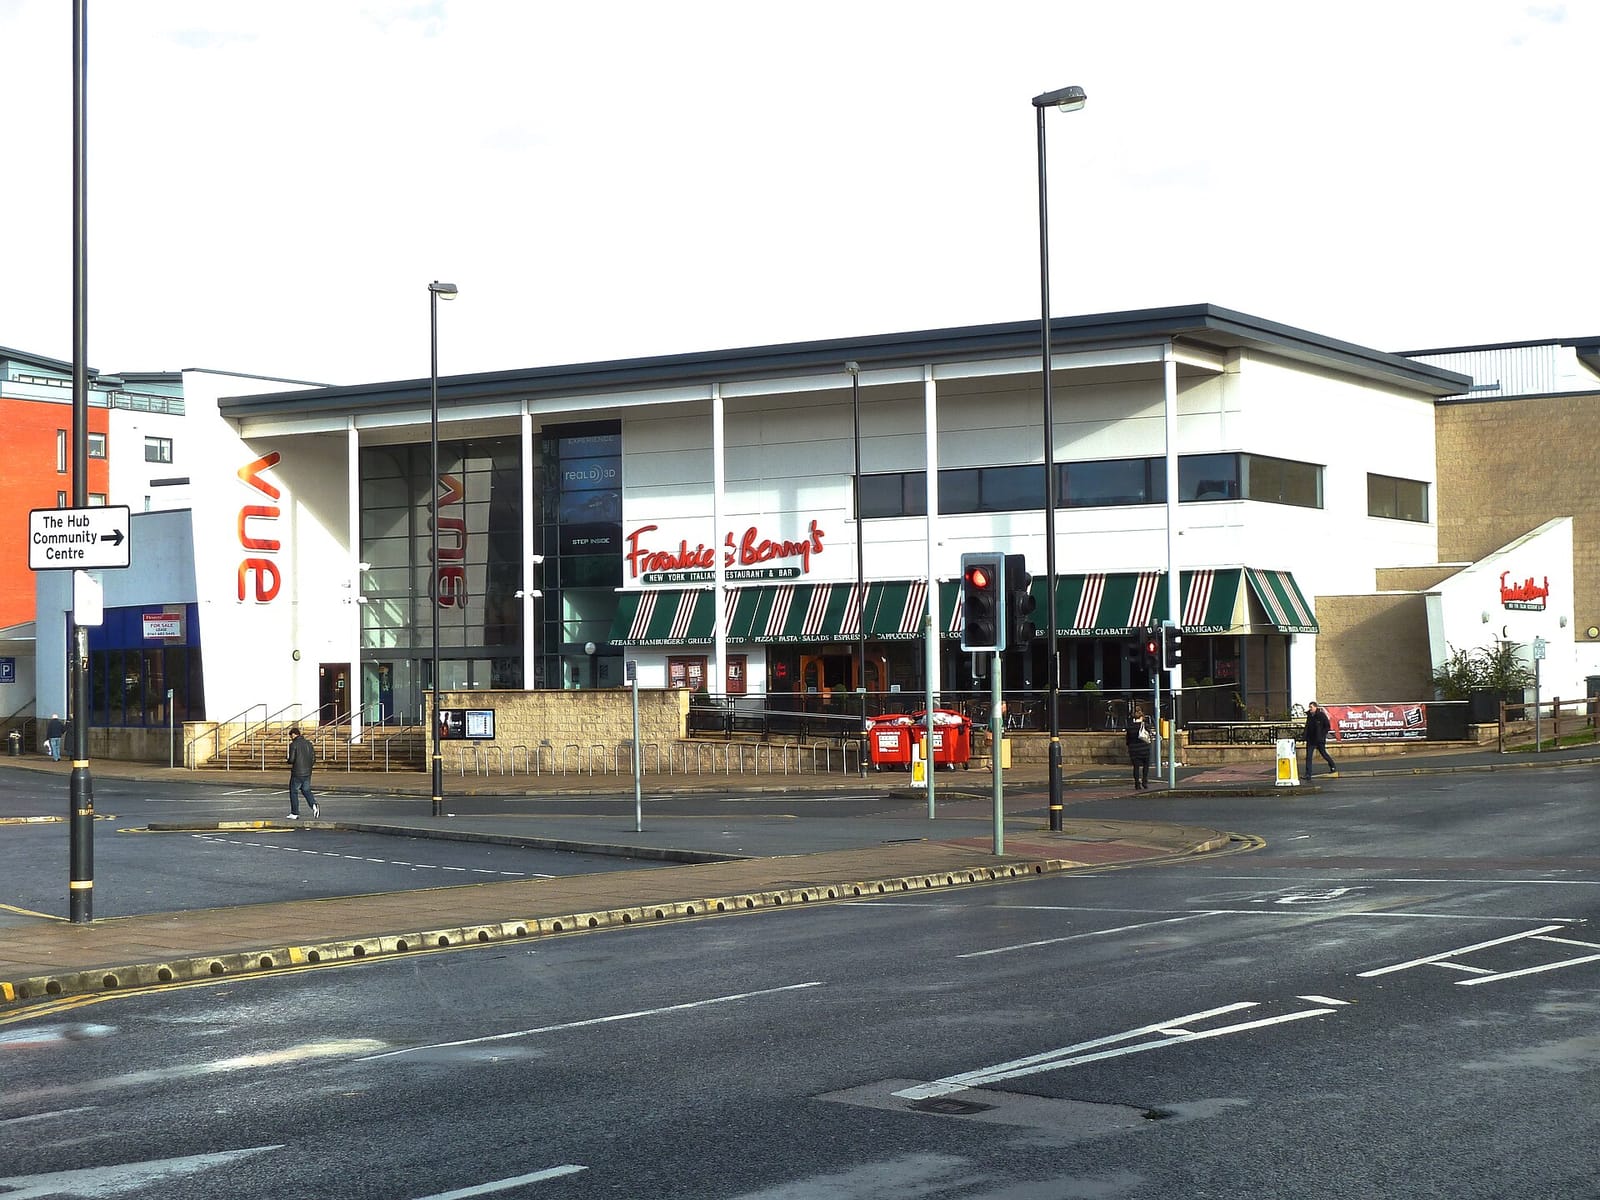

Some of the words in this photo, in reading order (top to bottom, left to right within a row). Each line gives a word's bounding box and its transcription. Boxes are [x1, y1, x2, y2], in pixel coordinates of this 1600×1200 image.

[603, 469, 616, 478] 3D
[43, 515, 63, 529] The
[67, 514, 90, 528] Hub
[237, 451, 281, 602] vue
[33, 530, 97, 544] Community
[46, 547, 84, 560] Centre
[626, 524, 716, 578] Frankie
[739, 519, 825, 574] Benny's
[649, 574, 664, 582] NEW
[668, 573, 685, 581] YORK
[690, 571, 716, 581] ITALIAN
[725, 570, 764, 579] ESTAURANT
[768, 569, 774, 577] &
[778, 568, 793, 577] BAR
[639, 638, 685, 646] HAMBURGERS
[687, 637, 713, 645] GRILLS
[802, 634, 830, 642] SALADS
[1055, 628, 1091, 636] UNDAES
[1180, 625, 1224, 633] ARMIGANA
